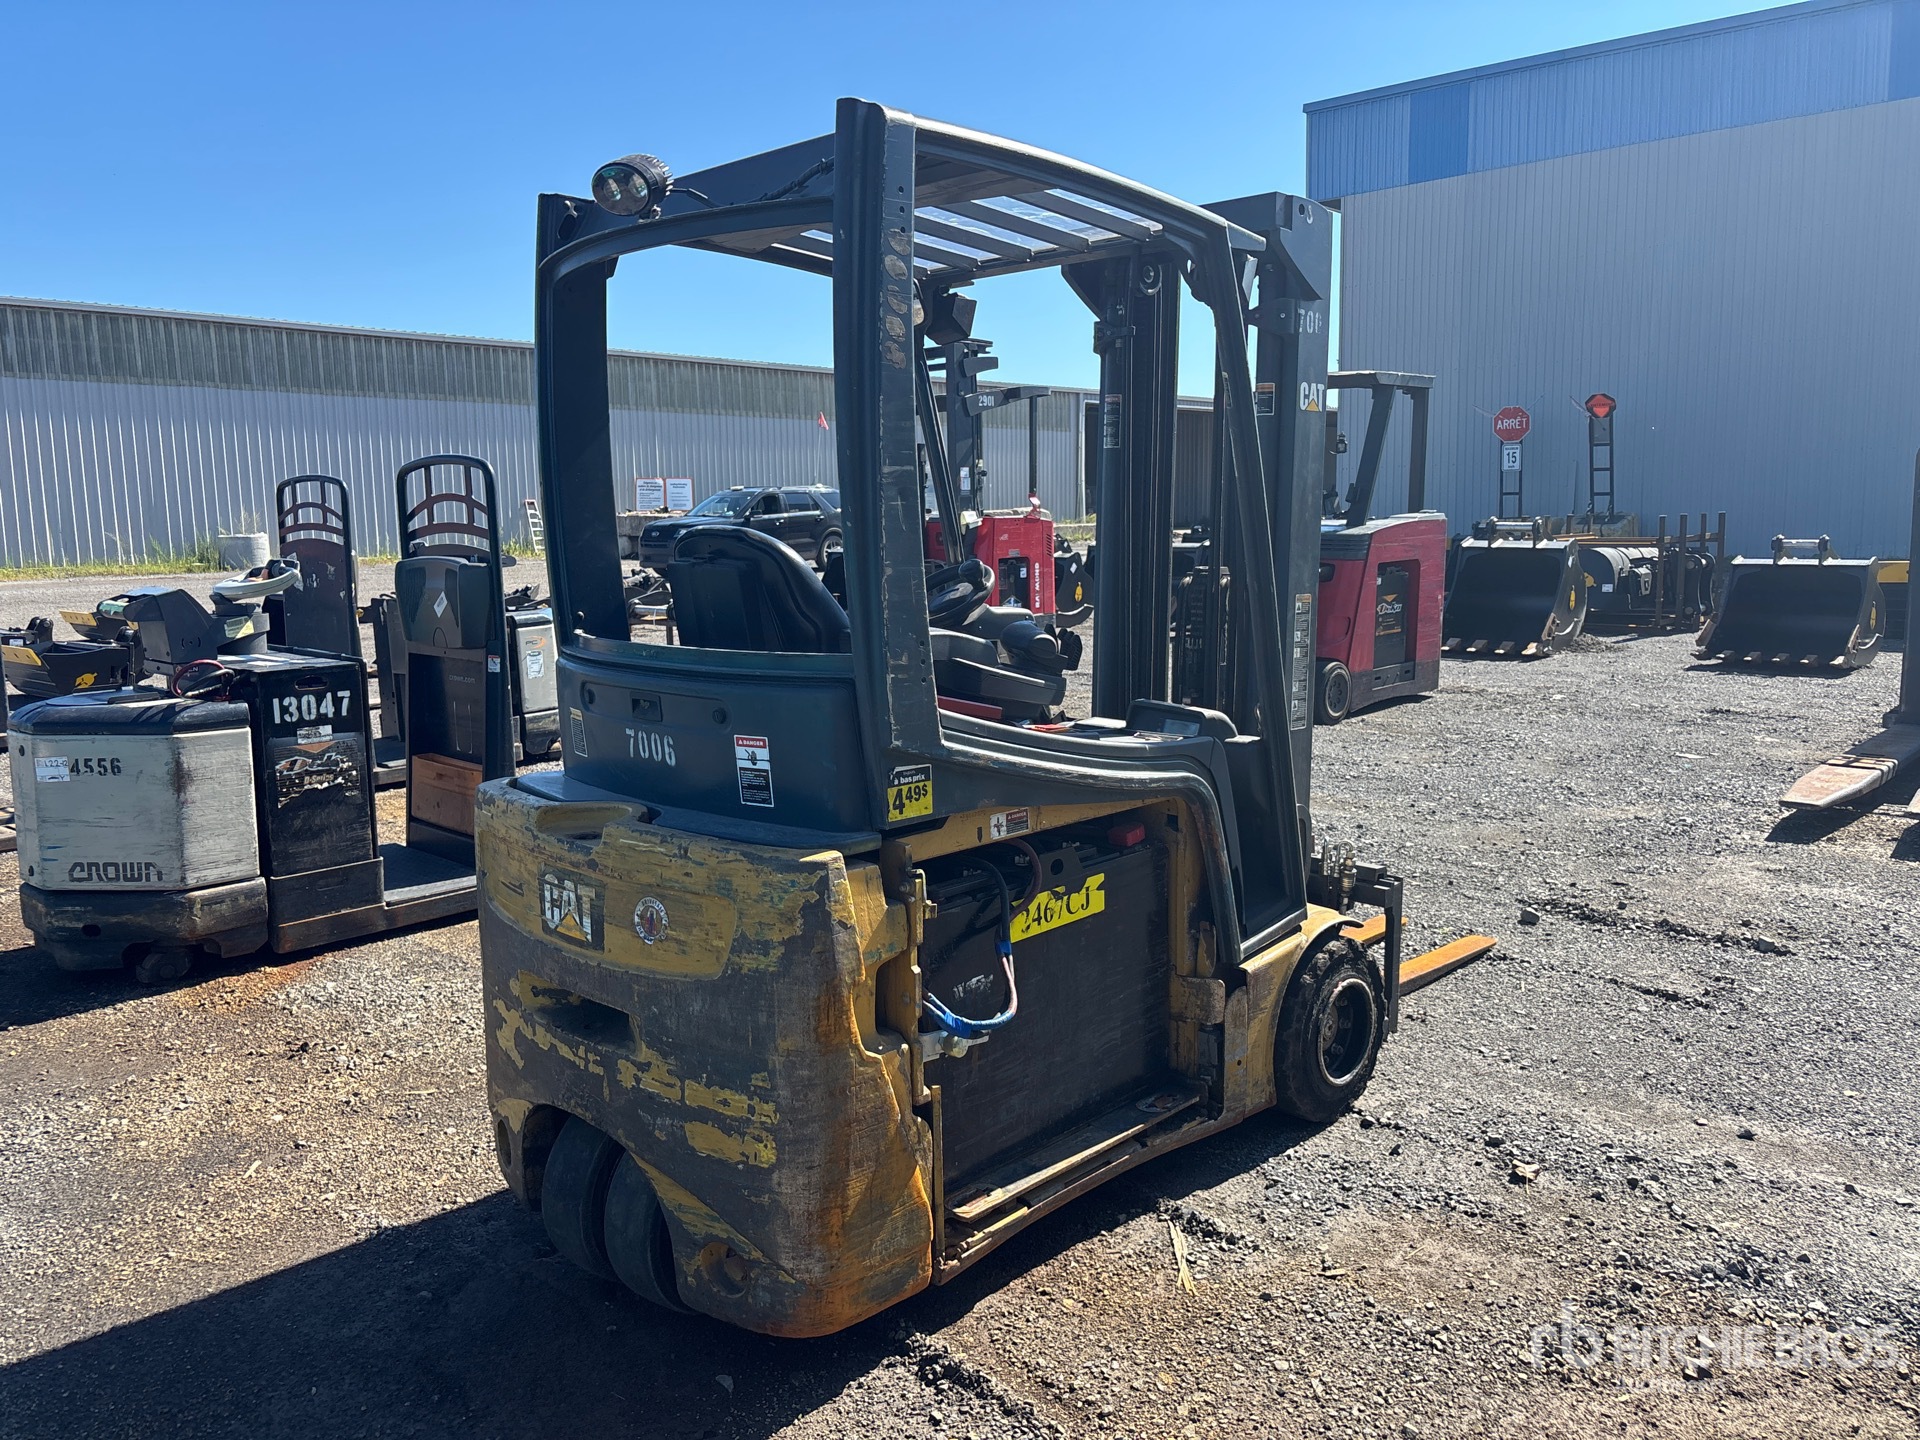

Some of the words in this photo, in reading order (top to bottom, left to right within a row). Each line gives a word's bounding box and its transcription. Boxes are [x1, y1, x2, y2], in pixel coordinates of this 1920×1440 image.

[978, 395, 995, 406] 2901
[1300, 381, 1325, 412] CAT
[1496, 416, 1528, 430] ARRÊT
[1506, 451, 1517, 464] 15
[272, 689, 351, 725] 13047
[625, 727, 677, 767] 7006
[70, 757, 122, 777] 4556
[900, 774, 913, 784] bas
[912, 773, 926, 783] prix
[68, 861, 164, 883] CROWN
[542, 873, 597, 943] CAT
